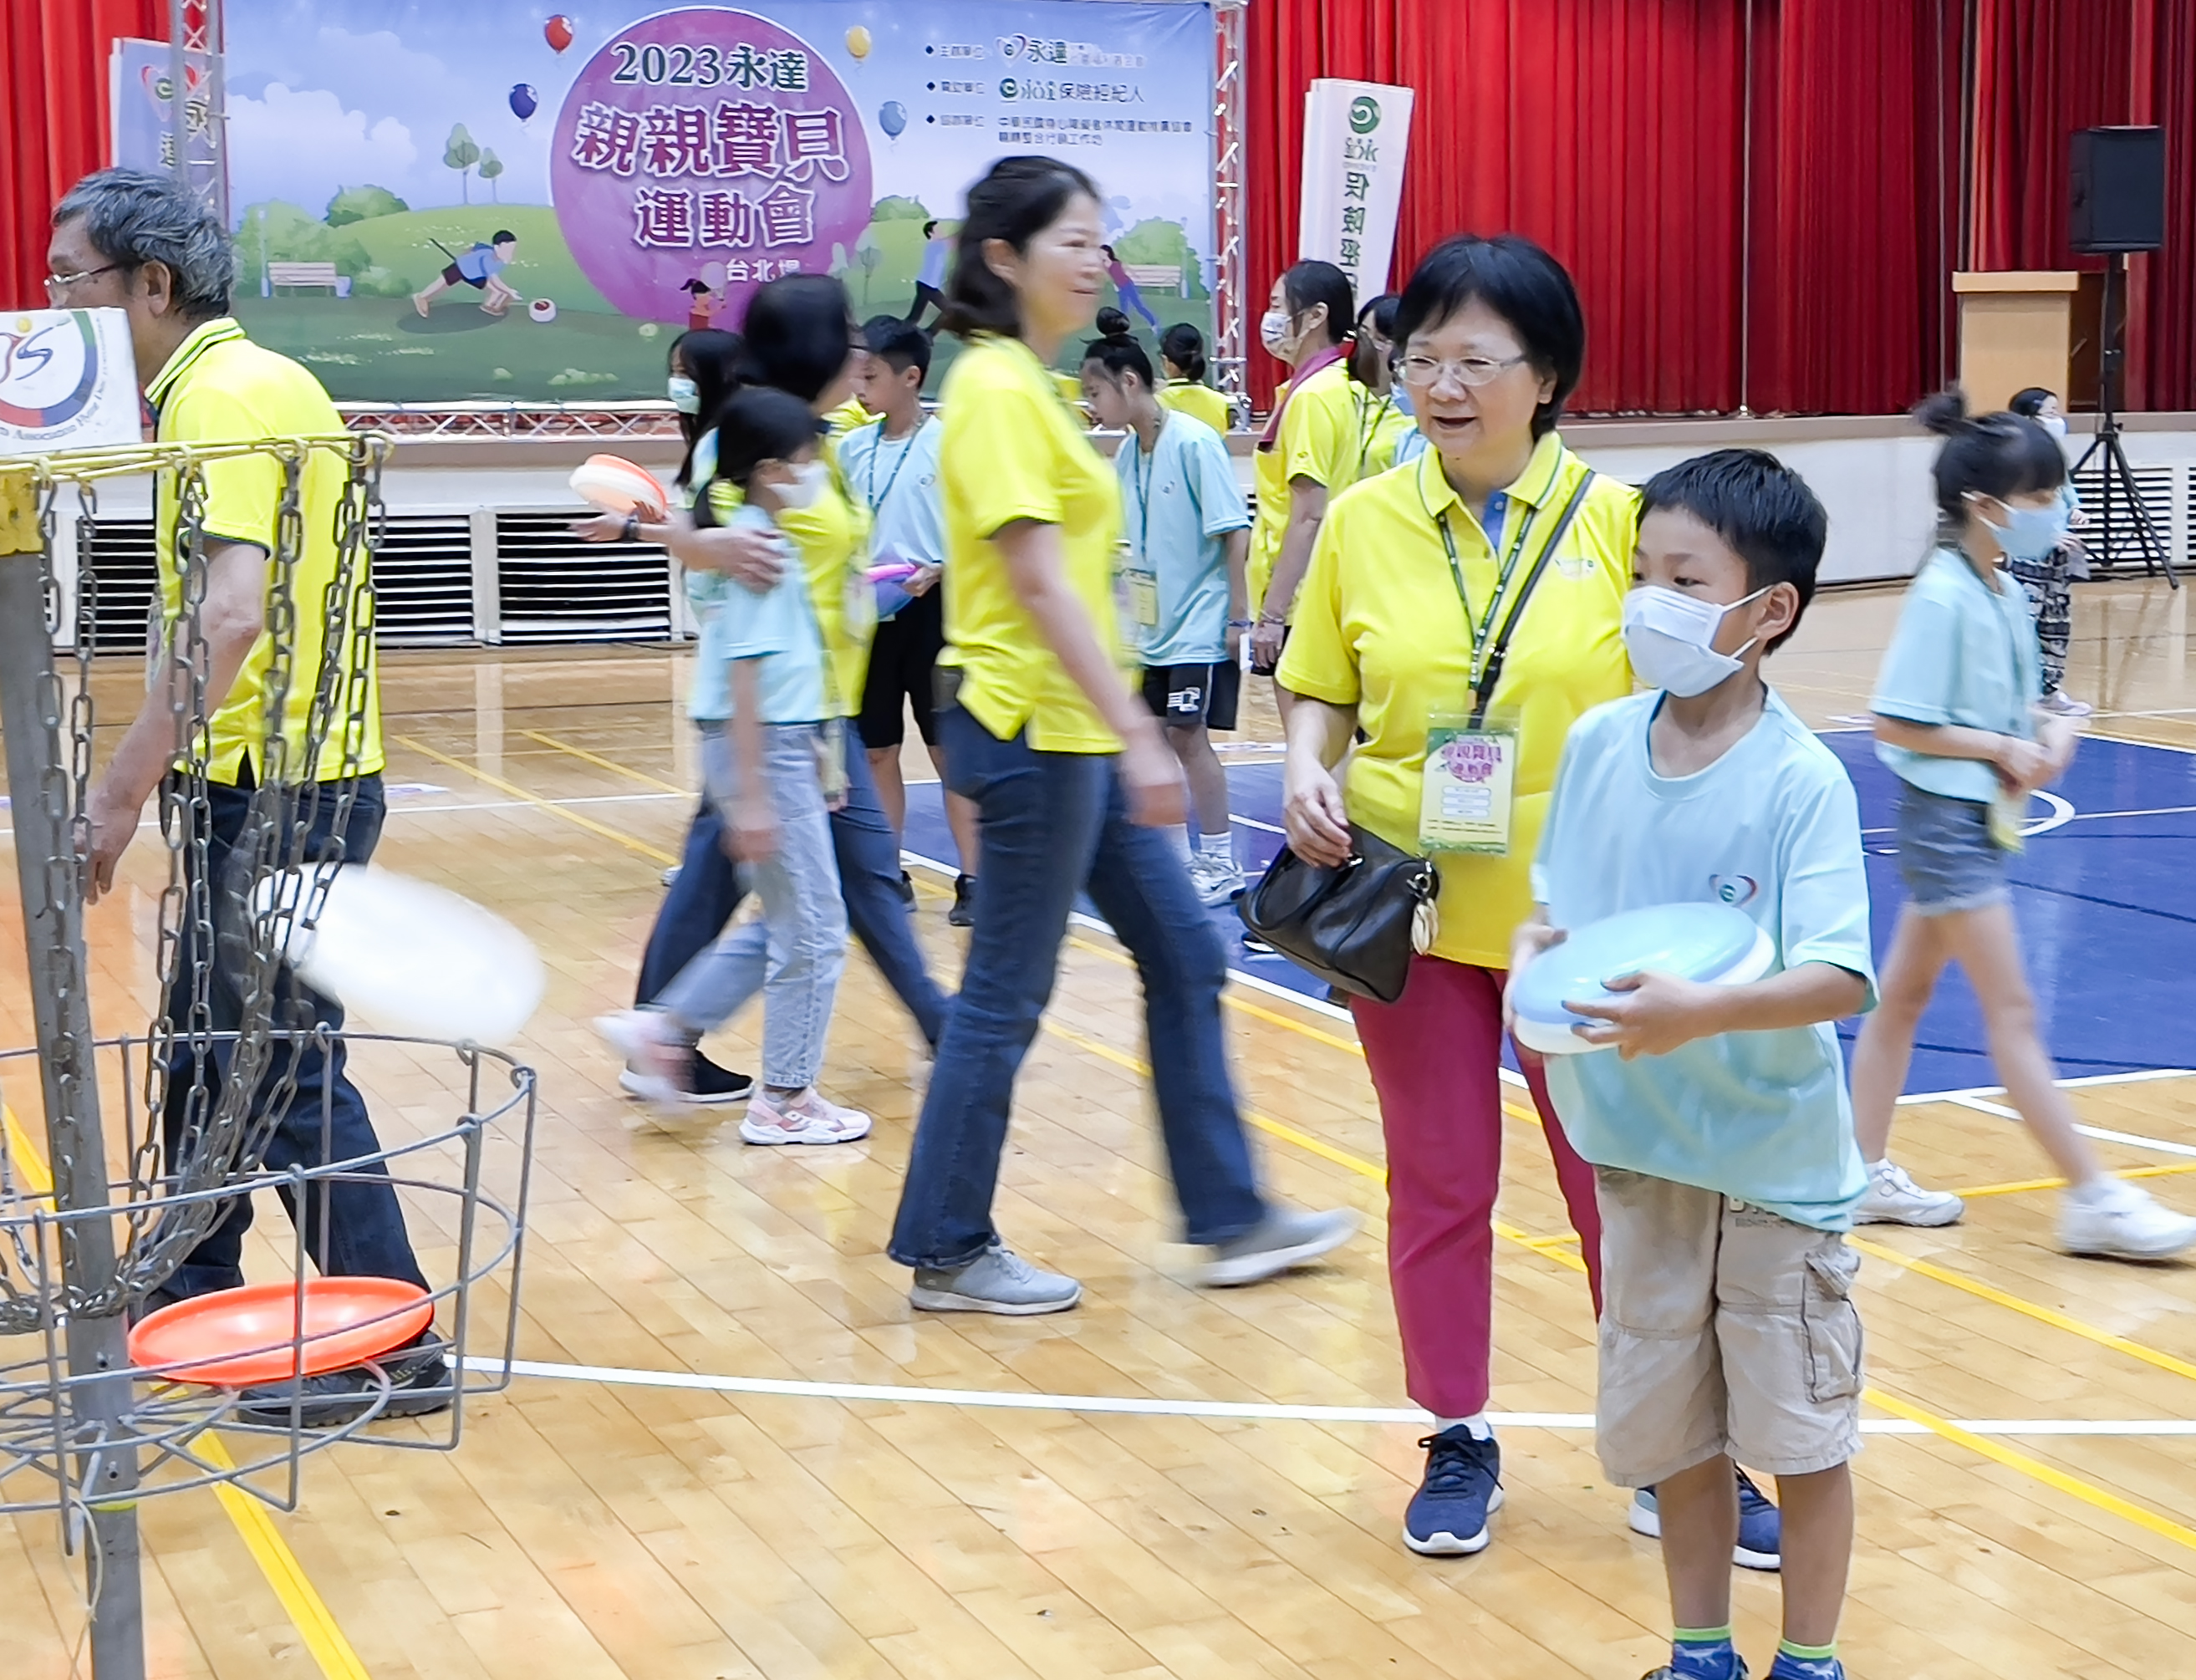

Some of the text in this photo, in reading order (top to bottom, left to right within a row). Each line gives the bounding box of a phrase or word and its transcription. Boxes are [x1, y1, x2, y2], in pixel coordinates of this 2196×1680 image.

[611, 41, 808, 92] 2023永達
[572, 99, 849, 182] 親親寶貝
[633, 181, 815, 248] 運動會
